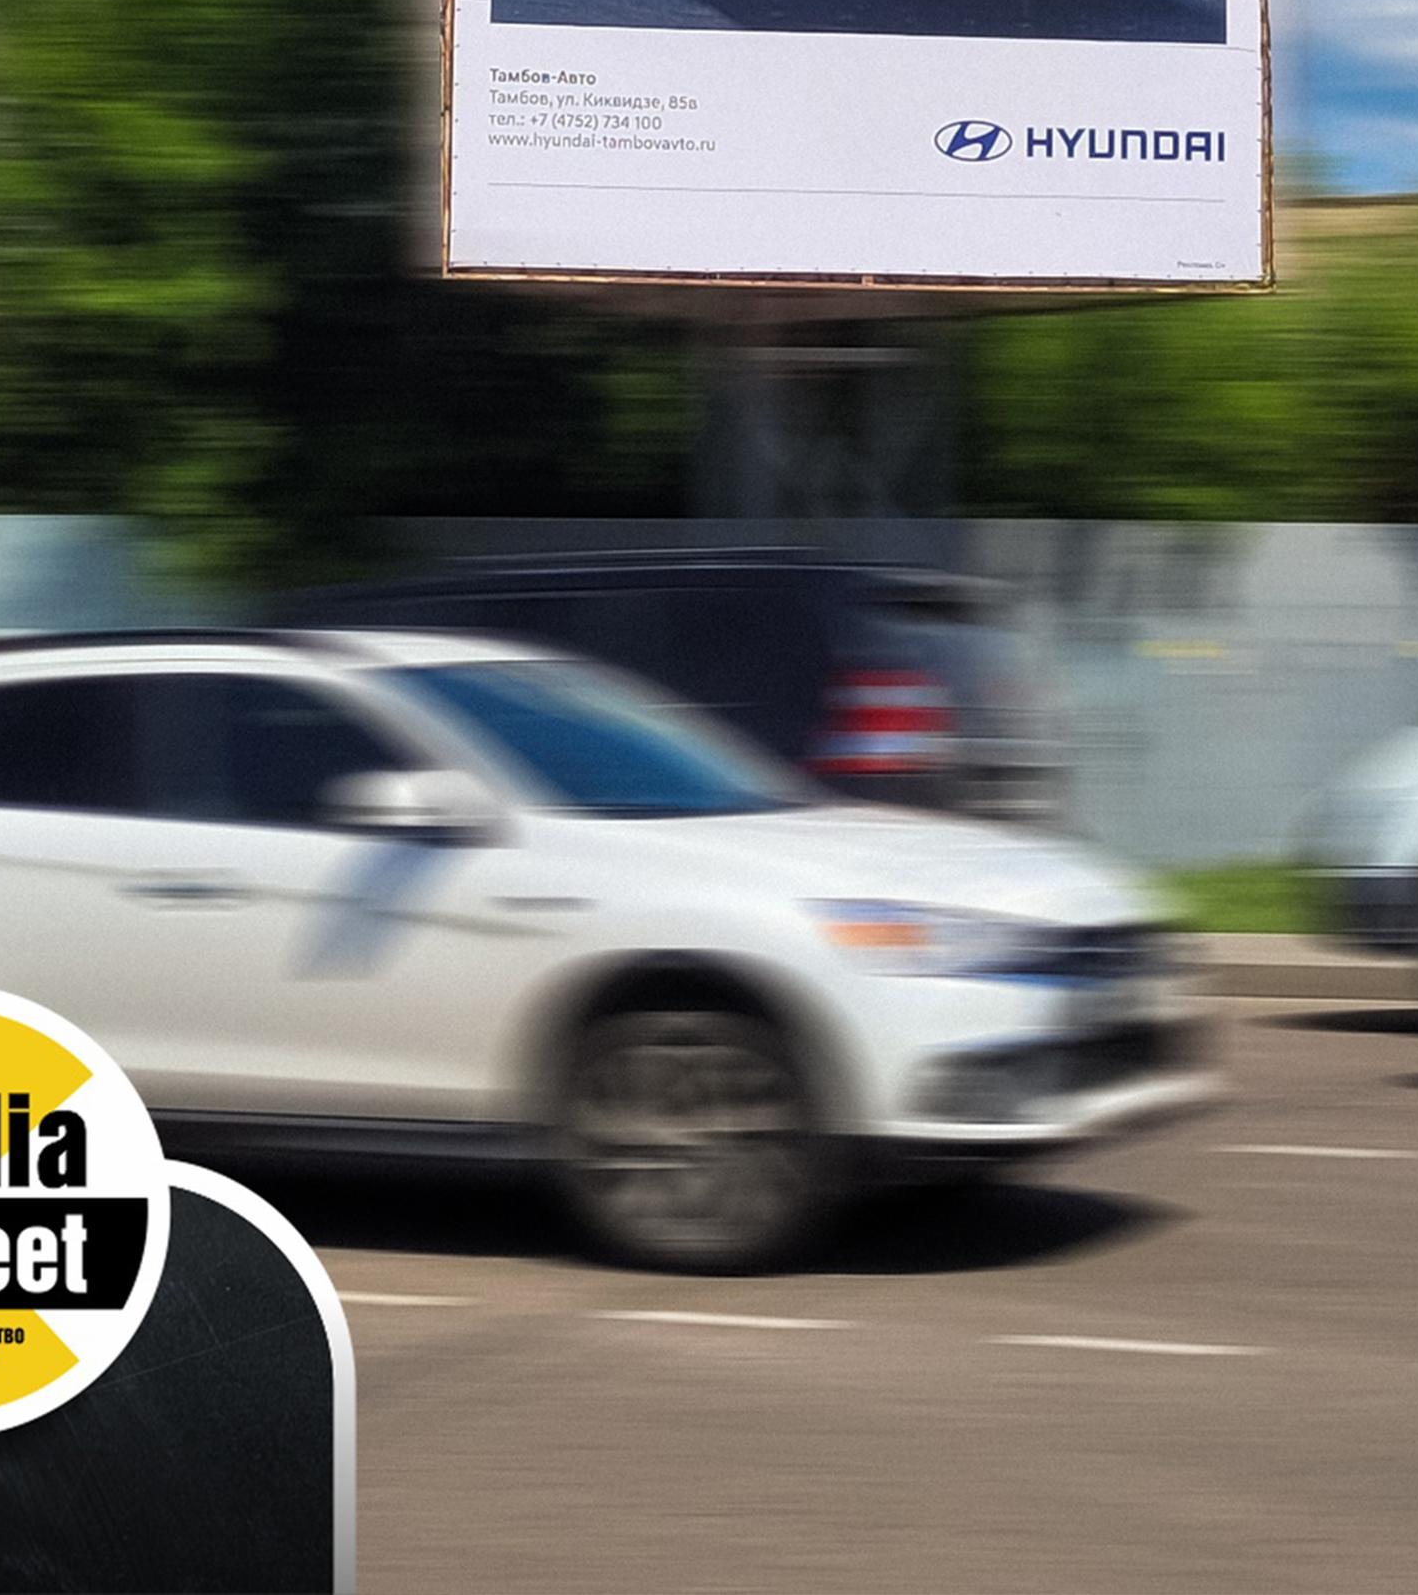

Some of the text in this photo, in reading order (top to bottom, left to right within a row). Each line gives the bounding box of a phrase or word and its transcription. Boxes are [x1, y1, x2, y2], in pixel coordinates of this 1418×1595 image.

[489, 67, 597, 86] Тамбов-Авто
[489, 89, 553, 109] Тамбов,
[557, 93, 580, 109] ул.
[583, 92, 665, 112] Киквидзе,
[488, 112, 662, 131] тел.: +7 (4752) 734 100
[488, 131, 716, 151] www.hyundai-tambovavto.ru
[1026, 126, 1225, 163] HYUNDAI
